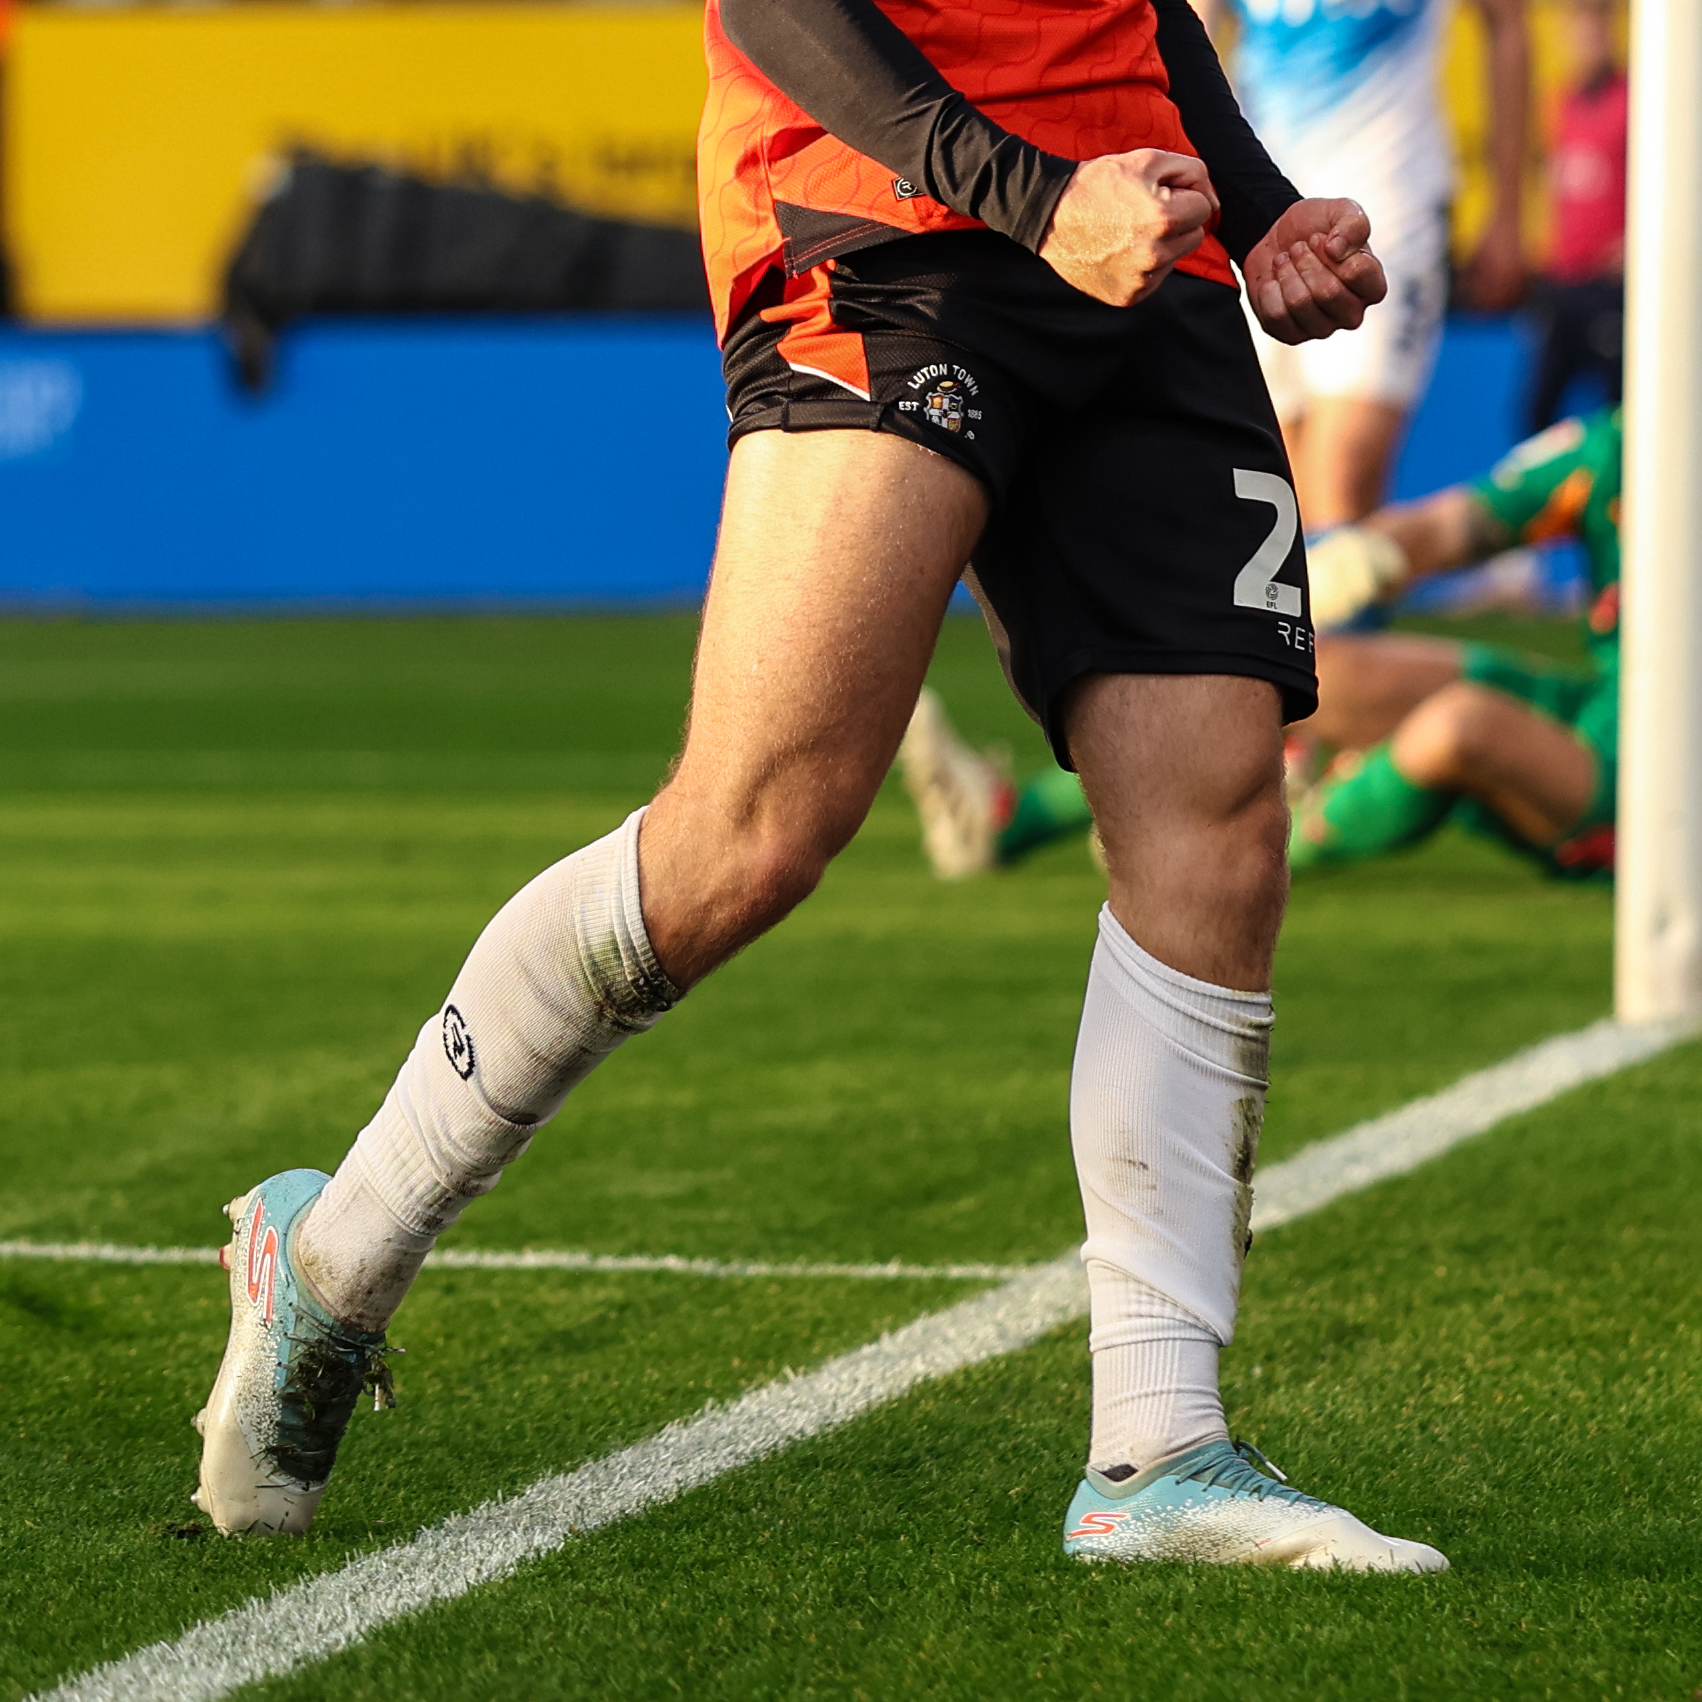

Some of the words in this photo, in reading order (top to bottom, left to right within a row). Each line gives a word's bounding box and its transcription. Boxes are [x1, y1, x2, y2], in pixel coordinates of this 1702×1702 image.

[907, 364, 948, 390] LUTON
[952, 364, 979, 396] TOWN
[898, 401, 919, 412] EST
[1232, 467, 1302, 618] 2
